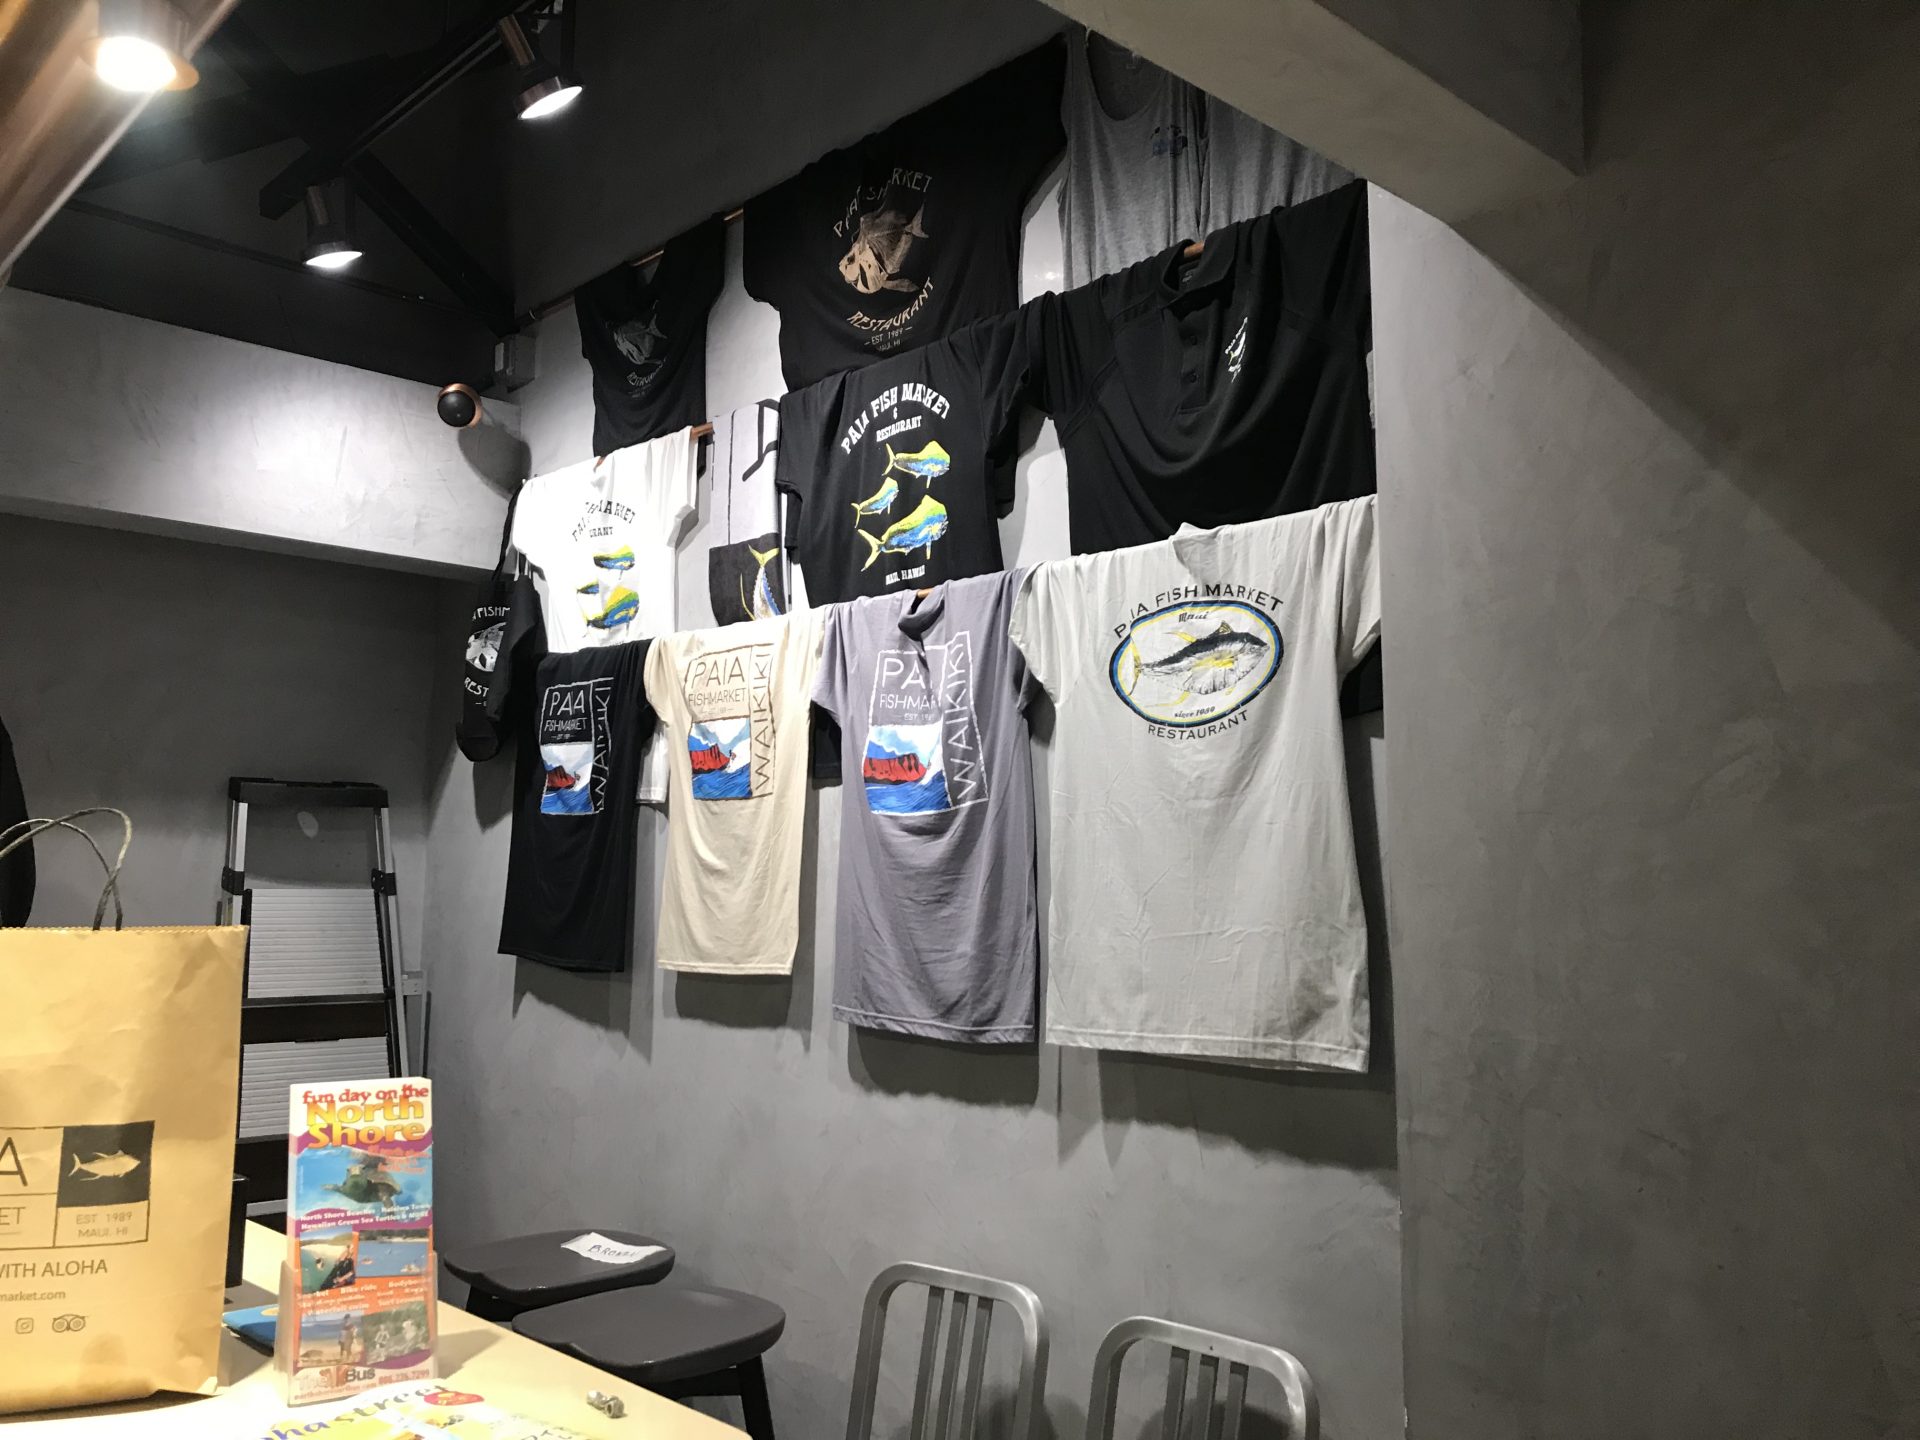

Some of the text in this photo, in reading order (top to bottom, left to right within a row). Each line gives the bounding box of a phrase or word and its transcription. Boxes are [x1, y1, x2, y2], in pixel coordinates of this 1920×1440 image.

[846, 276, 935, 332] RESTAURANT
[870, 386, 898, 418] FISH
[876, 415, 922, 442] RESTAURANT
[1113, 583, 1284, 639] PIA FISH MARKET
[691, 656, 745, 689] PAIA
[549, 689, 585, 717] PAA
[688, 687, 747, 708] FISHMARKET
[752, 653, 772, 791] WAIKIKI
[944, 643, 977, 800] WAIKIKI
[1148, 709, 1249, 741] RESTAURANT
[302, 1083, 430, 1106] fun day on the
[306, 1095, 425, 1127] North
[307, 1122, 426, 1149] Shore
[76, 1211, 133, 1225] EST 1989
[116, 1226, 128, 1237] HI
[41, 1258, 109, 1278] ALOHA
[345, 1368, 376, 1383] Bus
